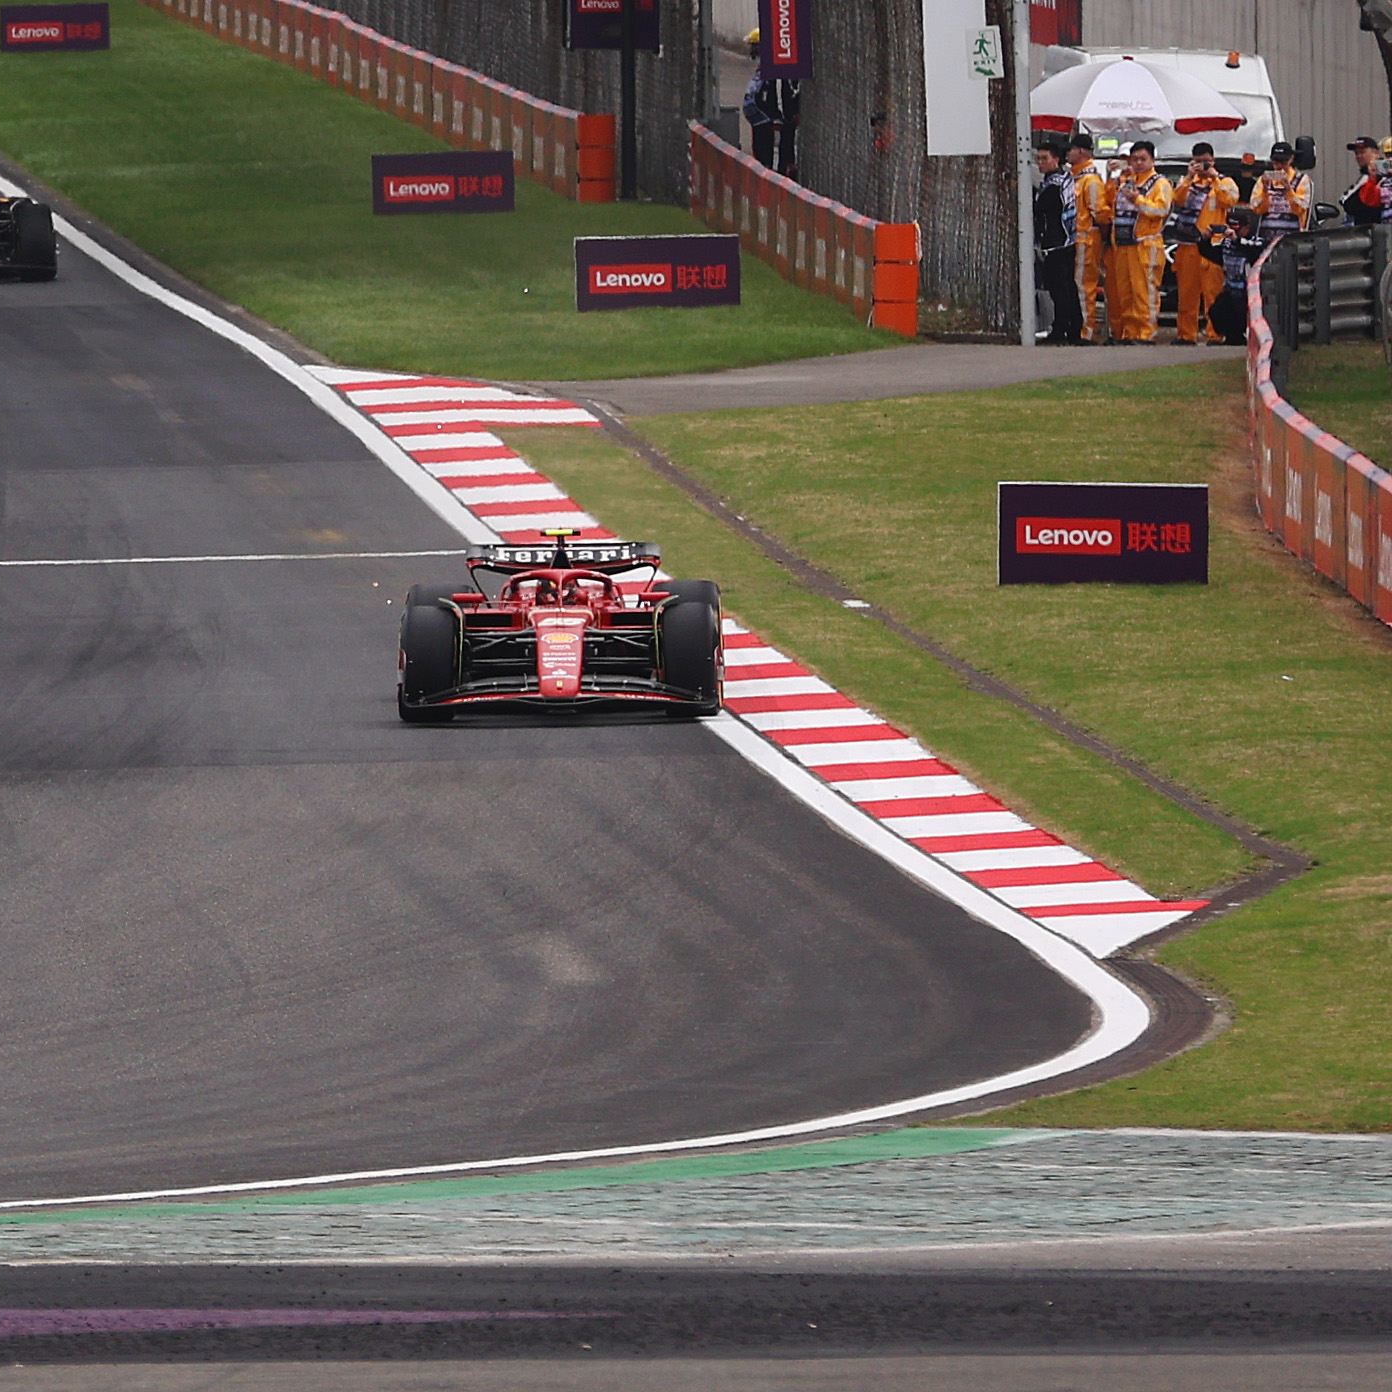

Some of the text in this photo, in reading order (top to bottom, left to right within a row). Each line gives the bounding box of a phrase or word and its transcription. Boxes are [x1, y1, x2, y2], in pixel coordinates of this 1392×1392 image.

[581, 0, 620, 9] Lenovo
[11, 26, 60, 39] Lenovo
[973, 58, 997, 66] EXIT
[389, 181, 450, 197] Lenovo
[596, 264, 728, 289] Lenovo 联想
[1025, 521, 1192, 553] Lenovo 联想
